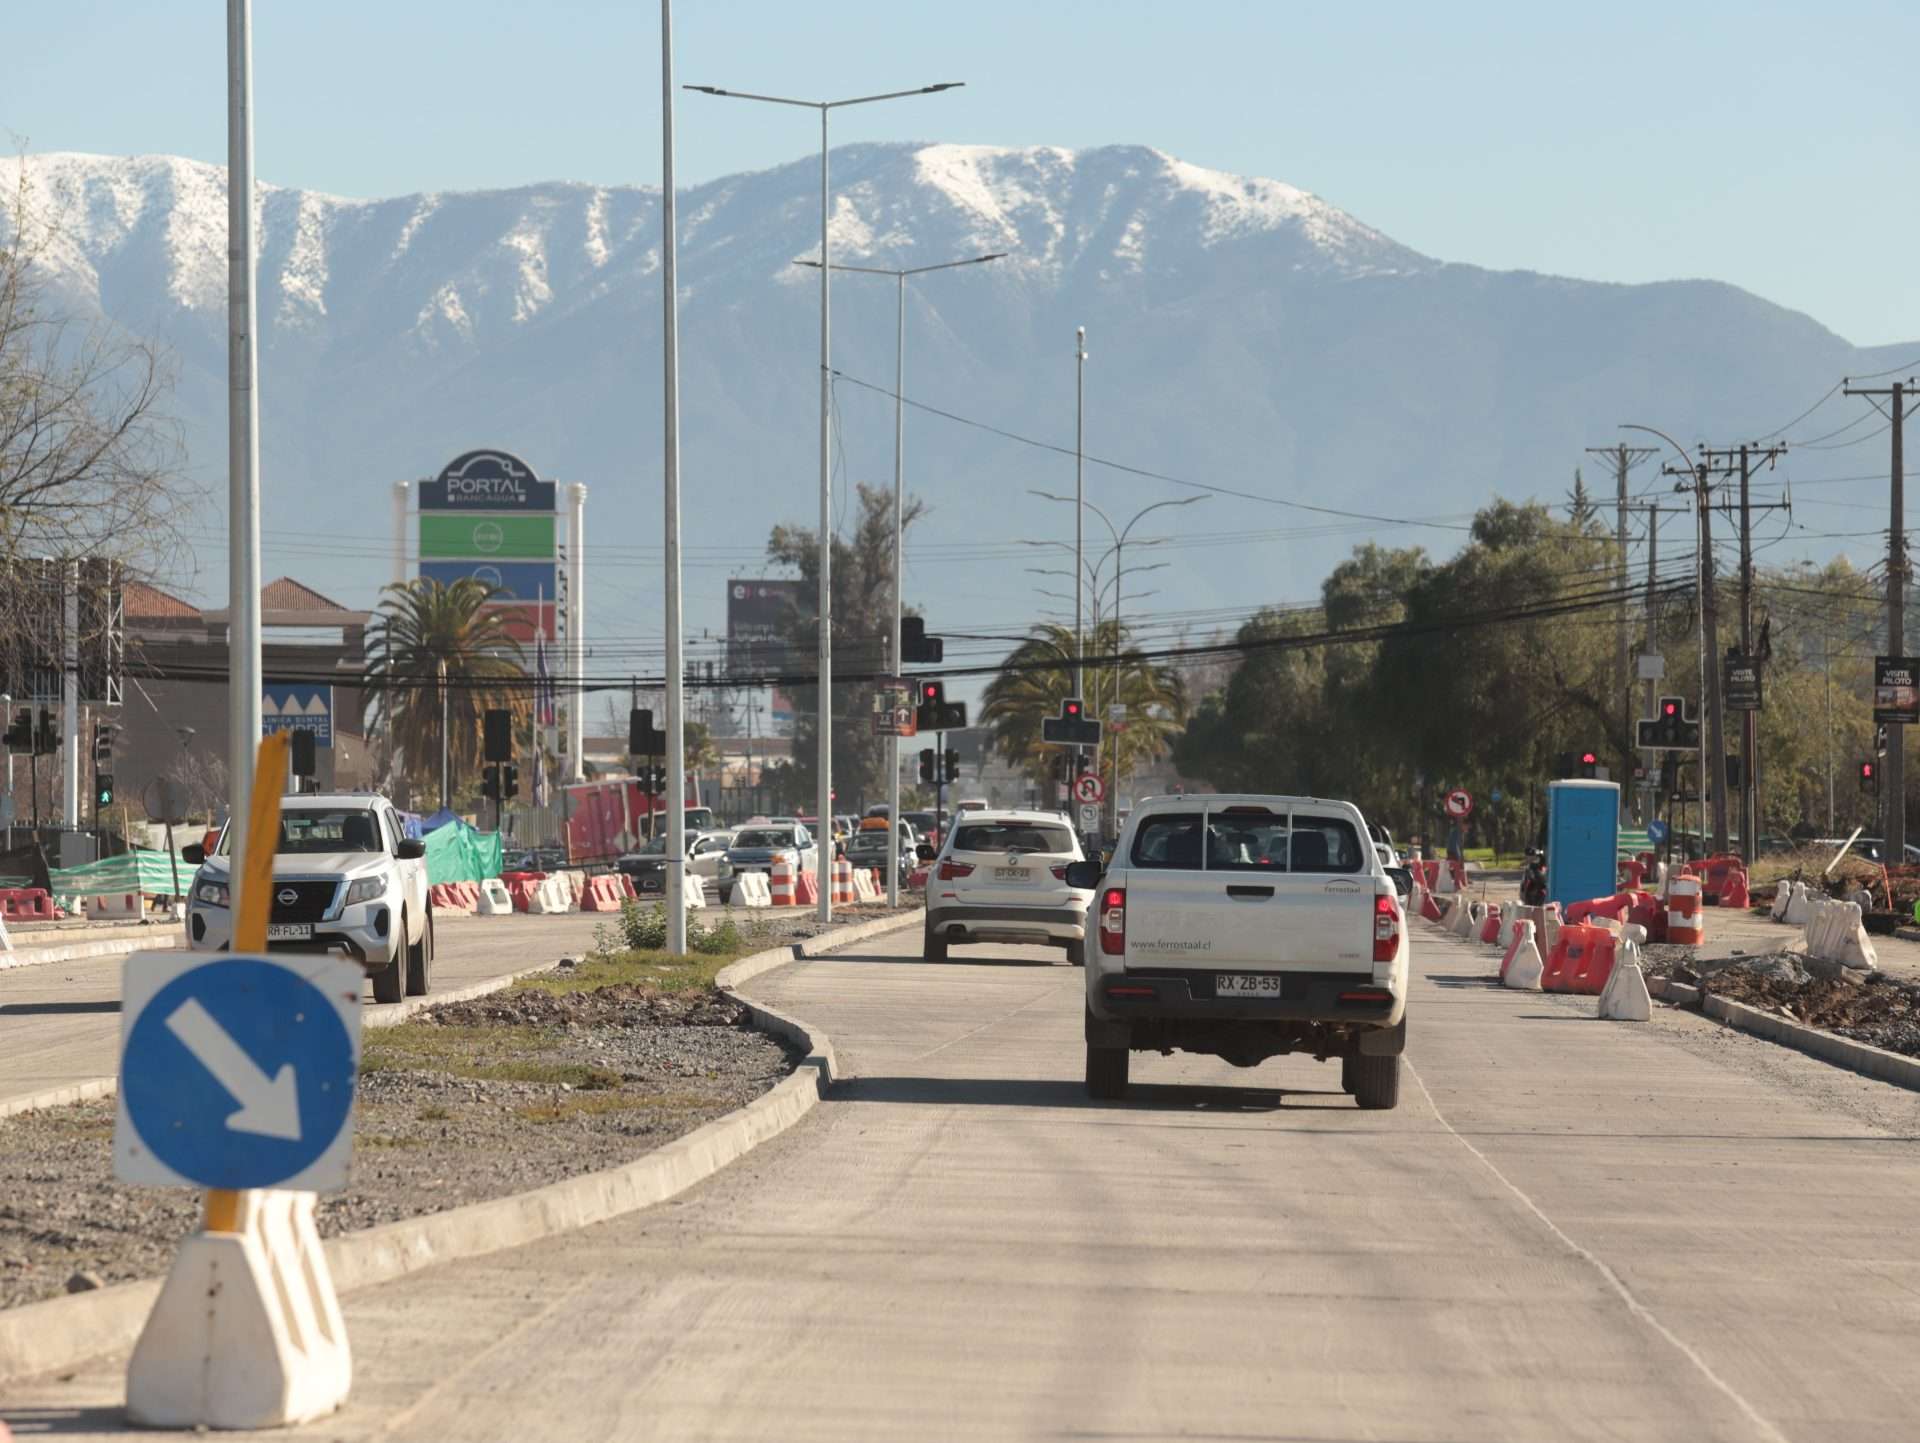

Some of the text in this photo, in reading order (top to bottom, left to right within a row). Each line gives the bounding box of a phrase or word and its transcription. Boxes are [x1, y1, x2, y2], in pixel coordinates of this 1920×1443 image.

[447, 478, 526, 493] PORTAL
[1882, 677, 1912, 685] PILOTO
[262, 716, 292, 724] LINICA
[1324, 886, 1361, 894] ferrostaal
[1130, 937, 1211, 950] www.ferrostaal.cl
